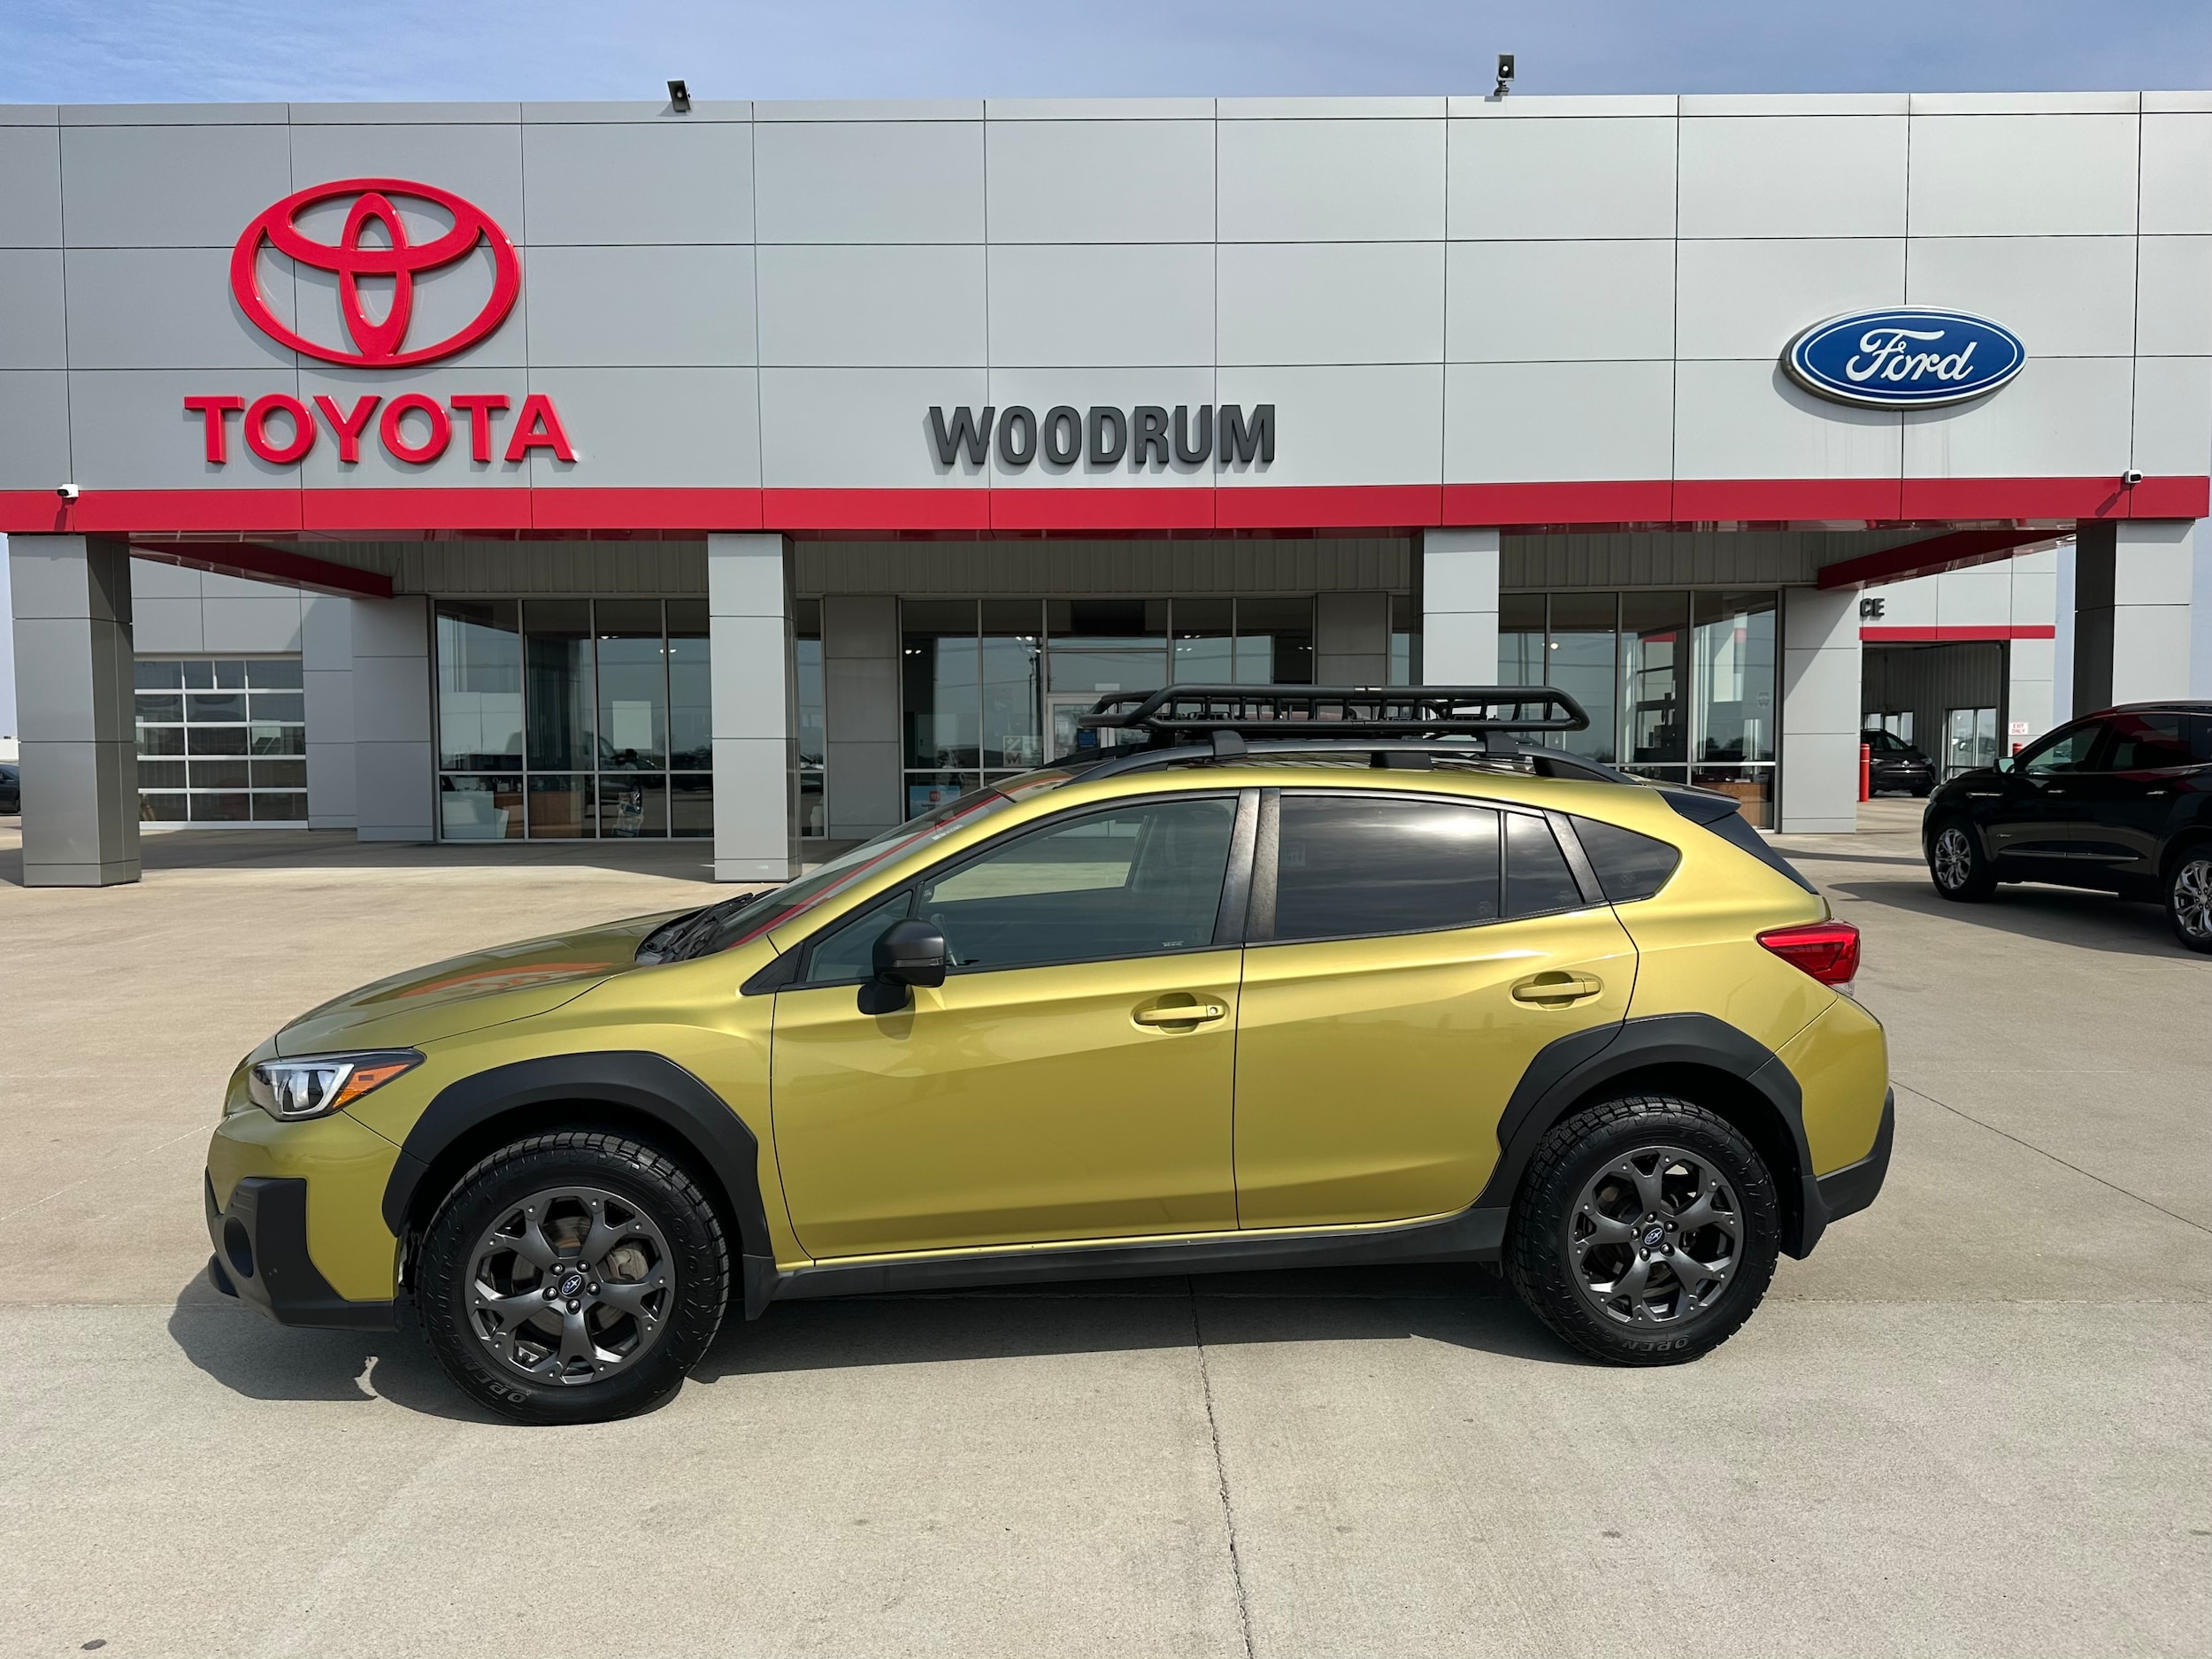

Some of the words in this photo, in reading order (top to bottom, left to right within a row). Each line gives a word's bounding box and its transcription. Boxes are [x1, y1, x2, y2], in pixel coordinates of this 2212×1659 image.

[1846, 328, 1978, 381] Ford
[184, 394, 578, 464] TOYOTA
[928, 404, 1275, 465] WOODRUM
[1860, 598, 1885, 617] CE
[1620, 1333, 1692, 1353] OPEN
[457, 1351, 529, 1405] OPEN
